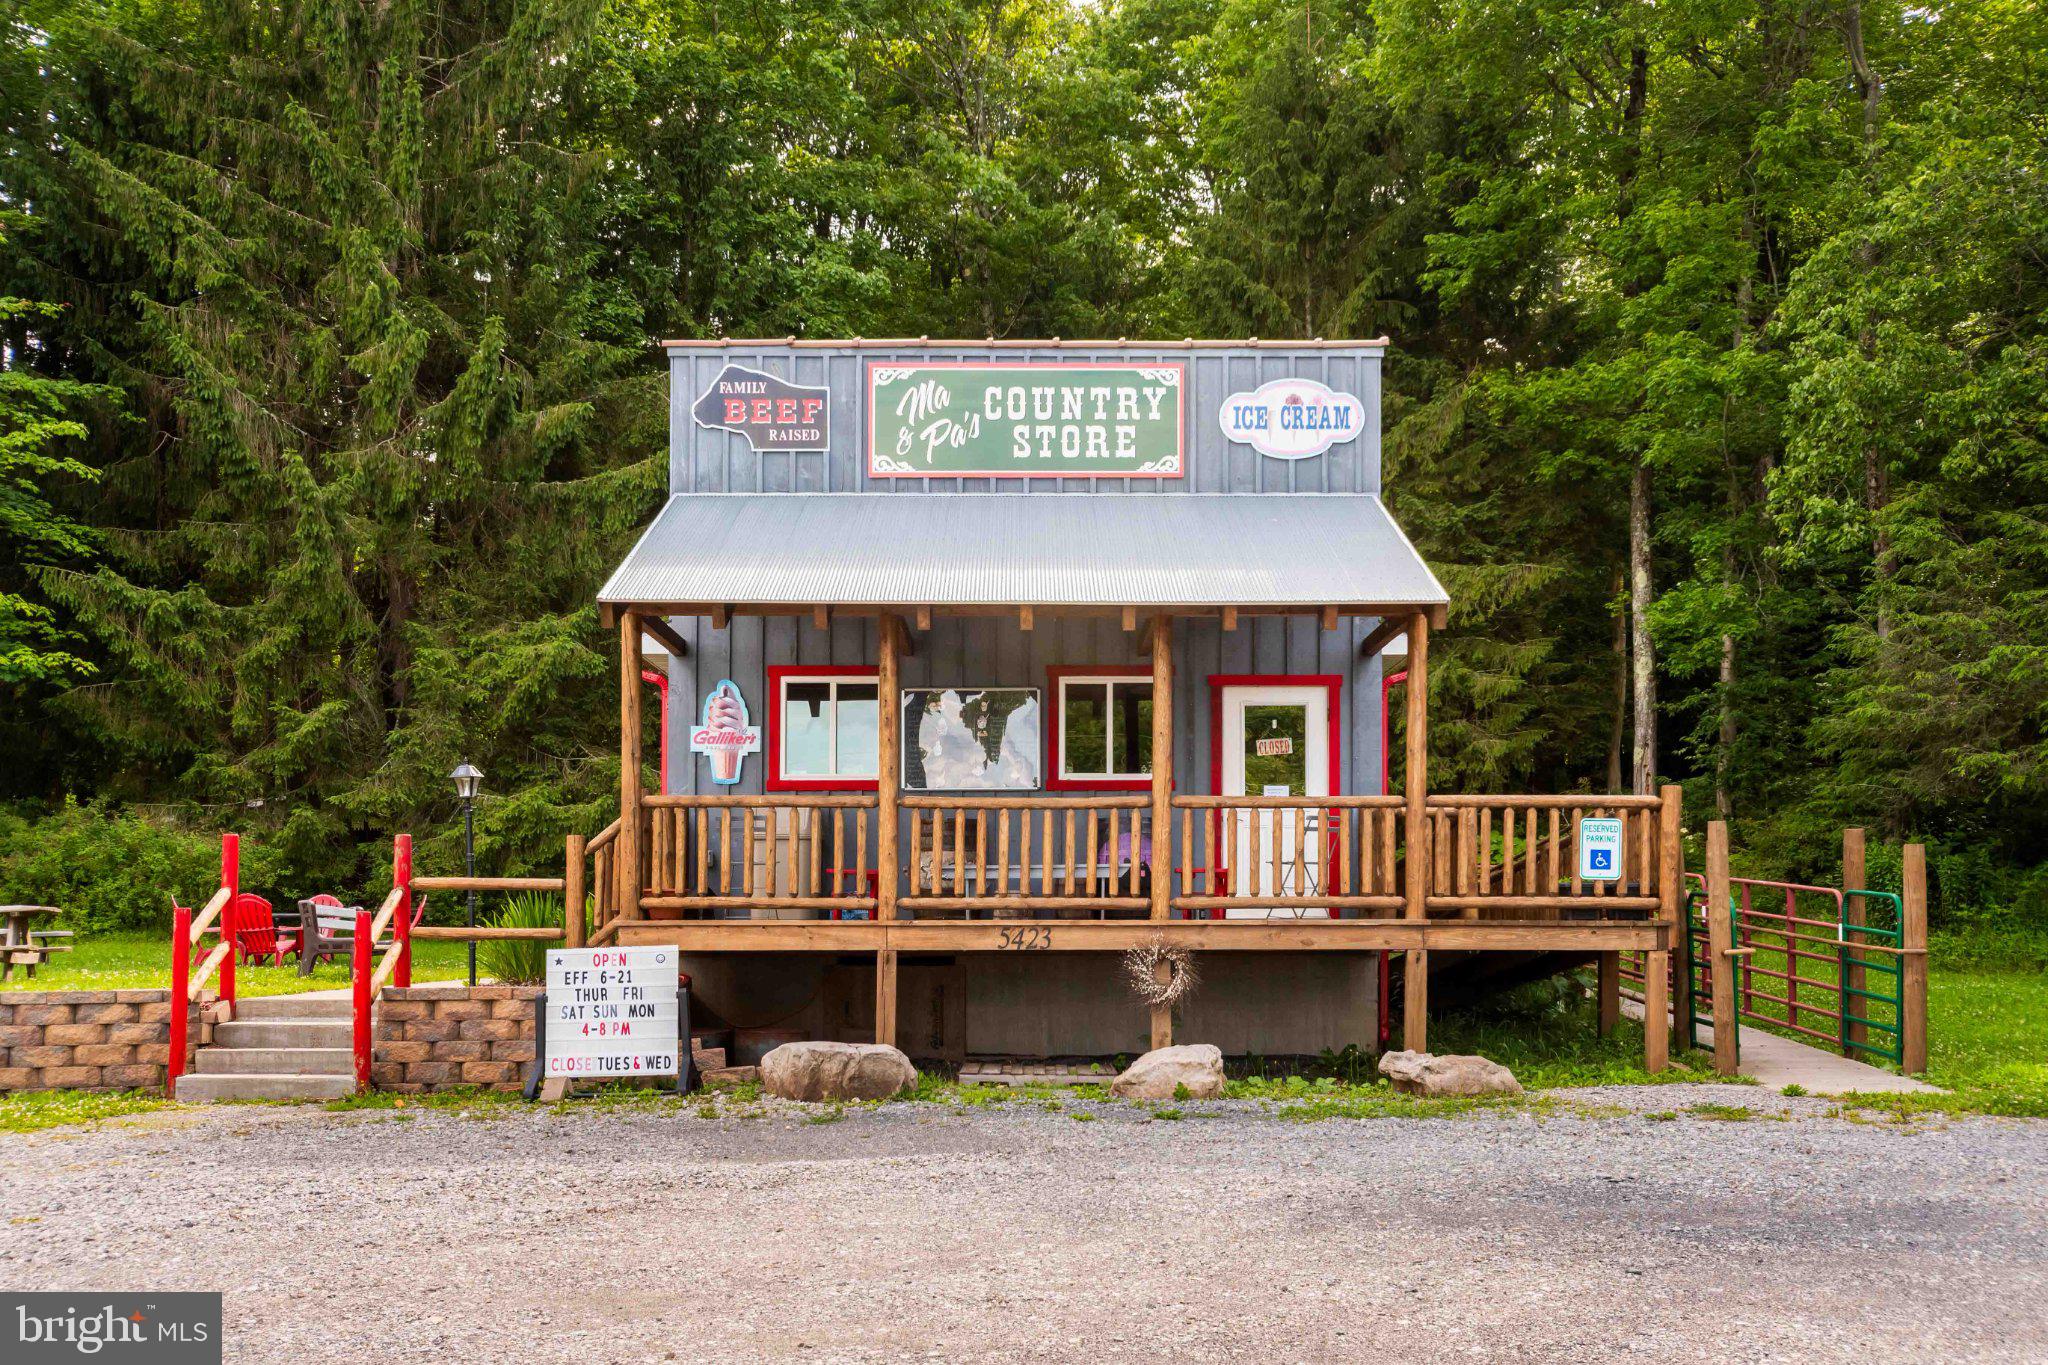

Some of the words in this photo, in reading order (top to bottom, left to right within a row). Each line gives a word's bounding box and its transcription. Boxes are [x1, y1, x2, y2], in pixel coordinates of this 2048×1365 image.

[719, 381, 767, 394] FAMILY
[895, 379, 951, 426] Ma
[983, 386, 1167, 421] COUNTRY
[723, 398, 823, 424] BEEF
[1232, 405, 1268, 430] ICE
[1280, 405, 1351, 430] CREAM
[768, 428, 820, 442] RAISED
[895, 424, 914, 455] &
[919, 410, 981, 464] Pa's
[1012, 425, 1137, 459] STORE
[693, 730, 757, 745] Galliker's
[1258, 739, 1290, 755] CLOSED
[1583, 824, 1619, 833] RESERVED
[1586, 834, 1616, 843] PARKING
[997, 927, 1052, 950] 5423
[593, 953, 627, 968] OPEN
[564, 971, 588, 985] EFF
[600, 970, 632, 984] 6-21
[575, 987, 608, 1002] THUR
[623, 986, 643, 1001] FRI
[561, 1005, 585, 1020] SAT
[593, 1004, 618, 1018] SUN
[628, 1004, 655, 1018] MON
[582, 1022, 606, 1036] 4-8
[612, 1022, 631, 1036] PM
[551, 1057, 592, 1072] CLOSE
[598, 1056, 630, 1071] TUES
[633, 1056, 641, 1070] &
[645, 1055, 672, 1070] WED
